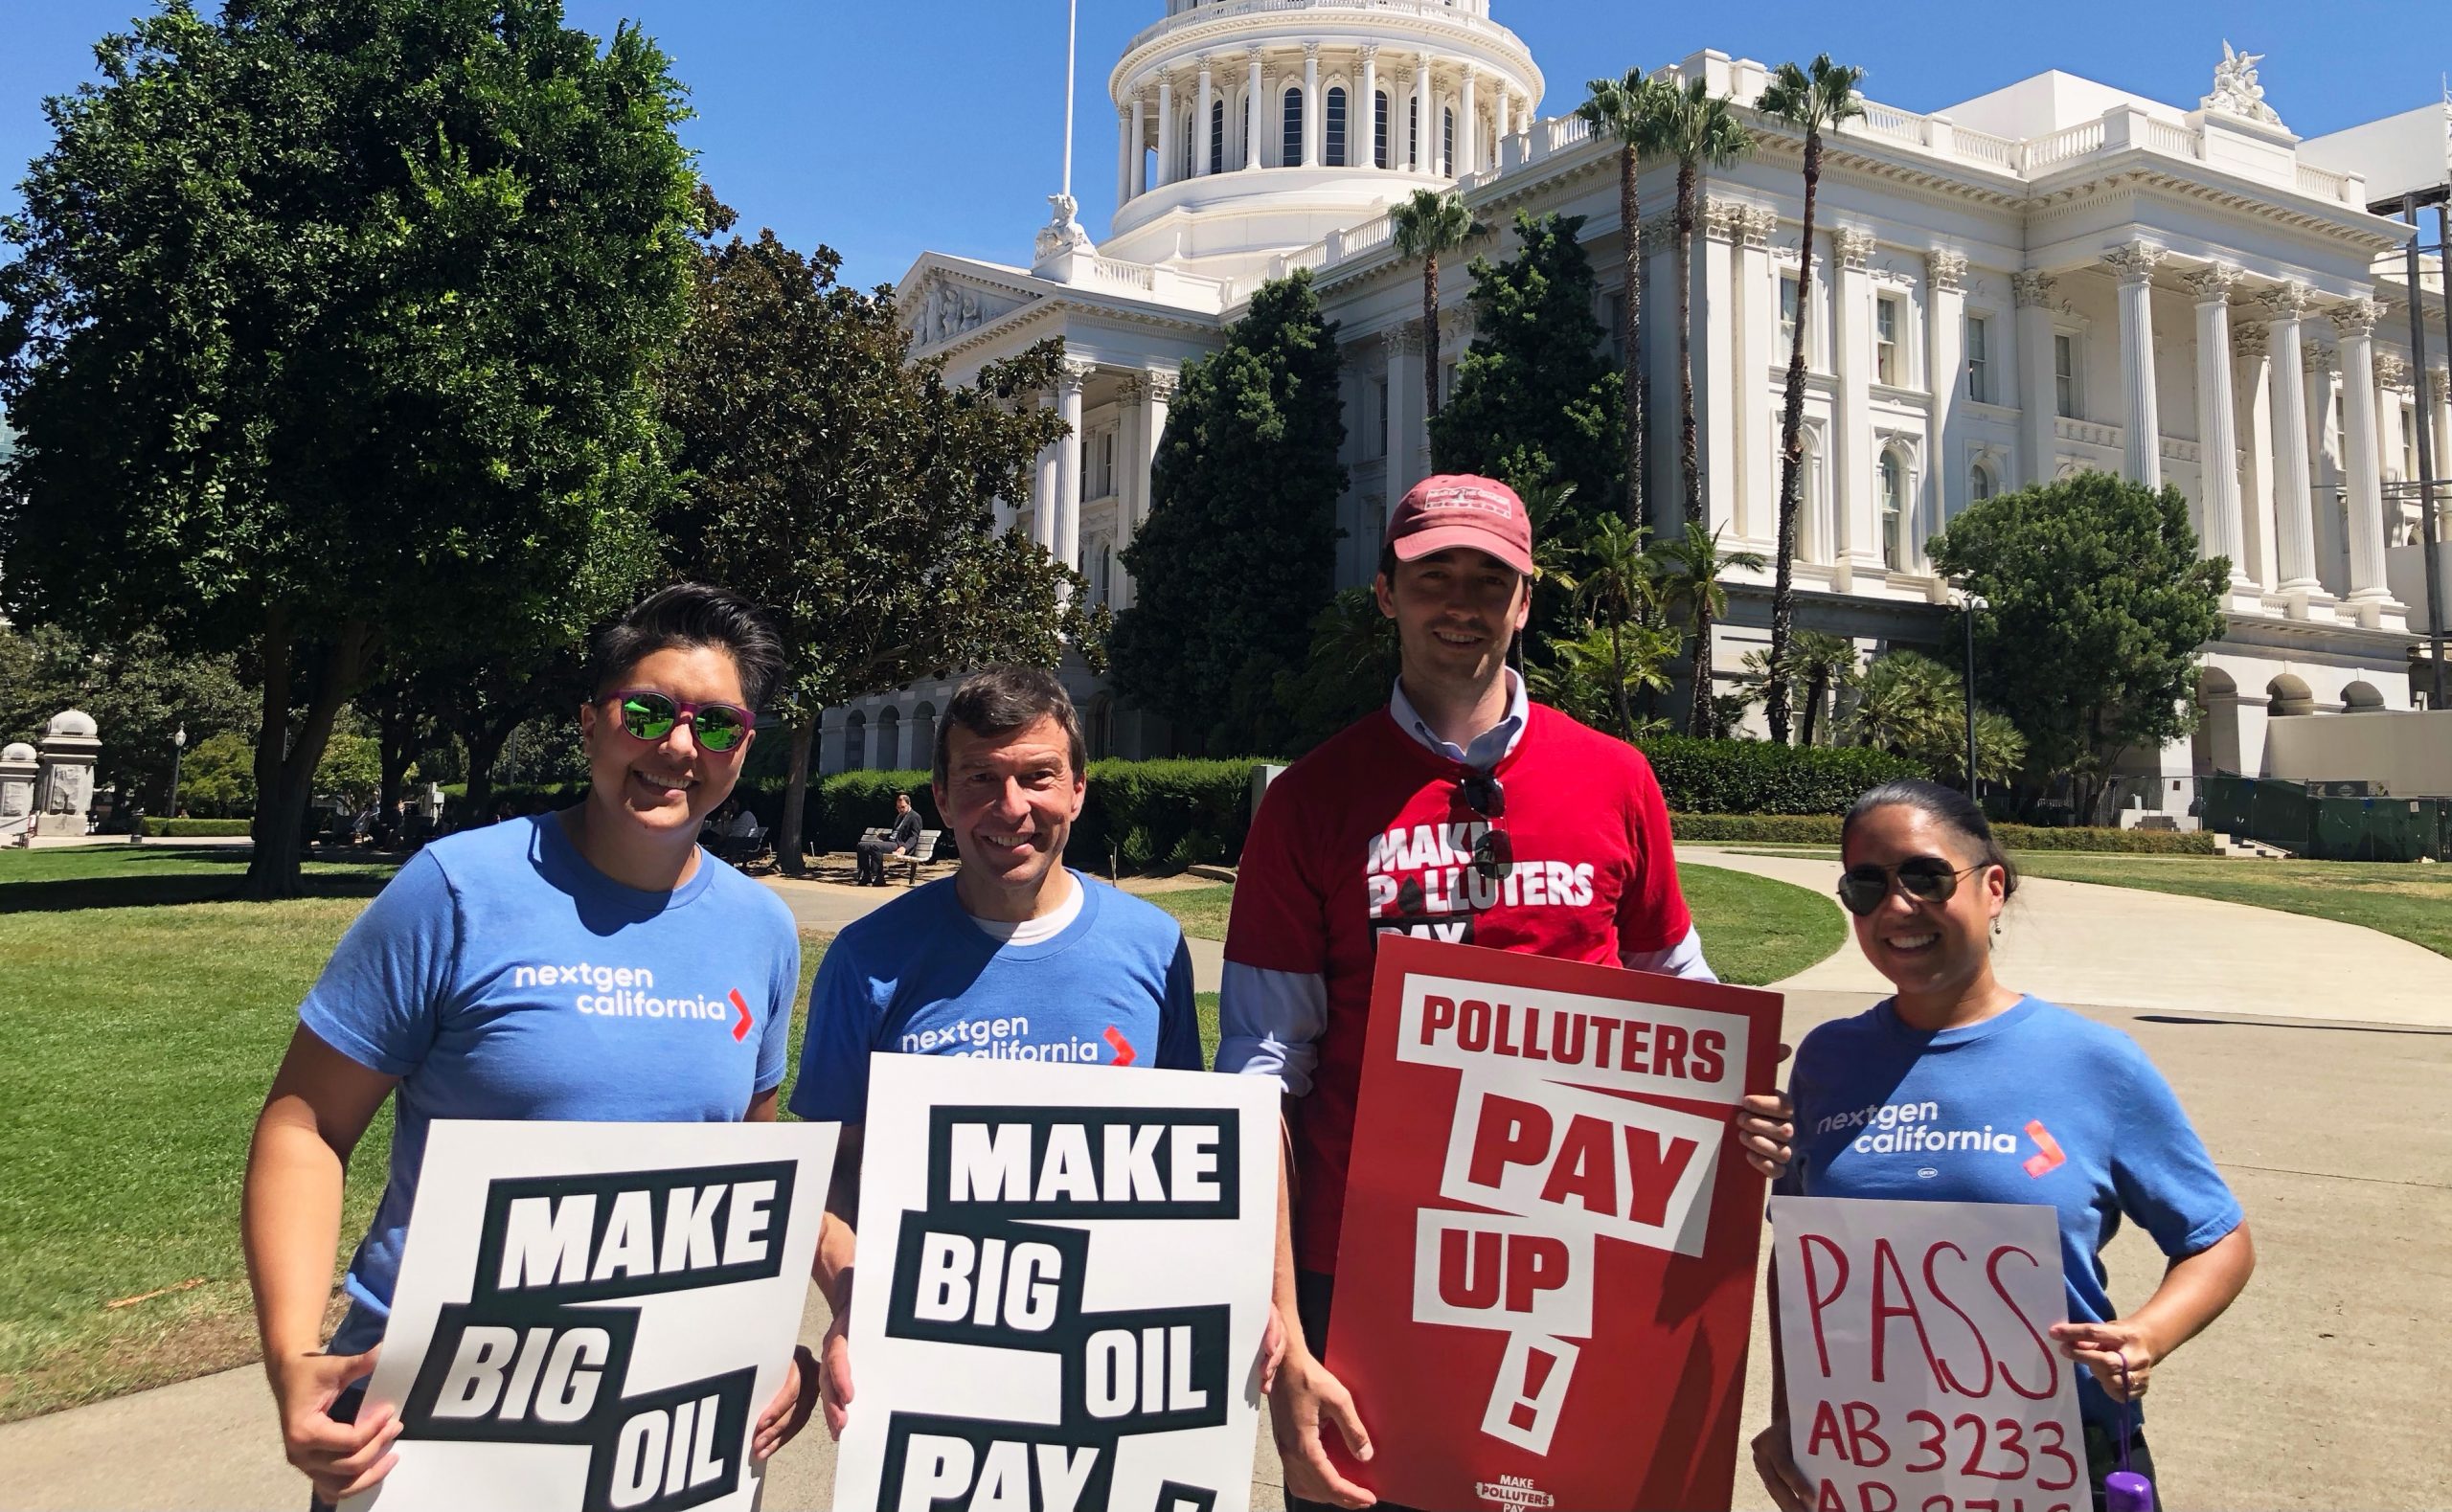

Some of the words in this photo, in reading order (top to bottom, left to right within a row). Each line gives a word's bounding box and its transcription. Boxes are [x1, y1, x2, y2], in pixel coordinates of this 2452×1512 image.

[515, 962, 653, 992] nextgen
[577, 989, 725, 1020] california
[902, 1016, 1029, 1052] nextgen
[954, 1036, 1098, 1062] lifornia
[1419, 995, 1725, 1083] POLLUTERS
[1467, 1092, 1699, 1228] PAY
[1817, 1101, 1938, 1134] nextgen
[1854, 1125, 2017, 1154] california
[950, 1122, 1221, 1202] MAKE
[498, 1180, 777, 1291] MAKE
[1439, 1228, 1570, 1313] UP
[914, 1231, 1062, 1332] BIG
[1799, 1233, 2058, 1400] PASS
[431, 1325, 611, 1422] BIG
[1085, 1325, 1208, 1419] OIL
[1508, 1345, 1557, 1433] !
[610, 1395, 724, 1509] OIL
[897, 1433, 1101, 1512] PAY
[1500, 1475, 1534, 1489] MAKE
[1807, 1399, 1892, 1468] AB
[1905, 1410, 2078, 1491] 3233
[1481, 1485, 1550, 1505] POLLUTERS
